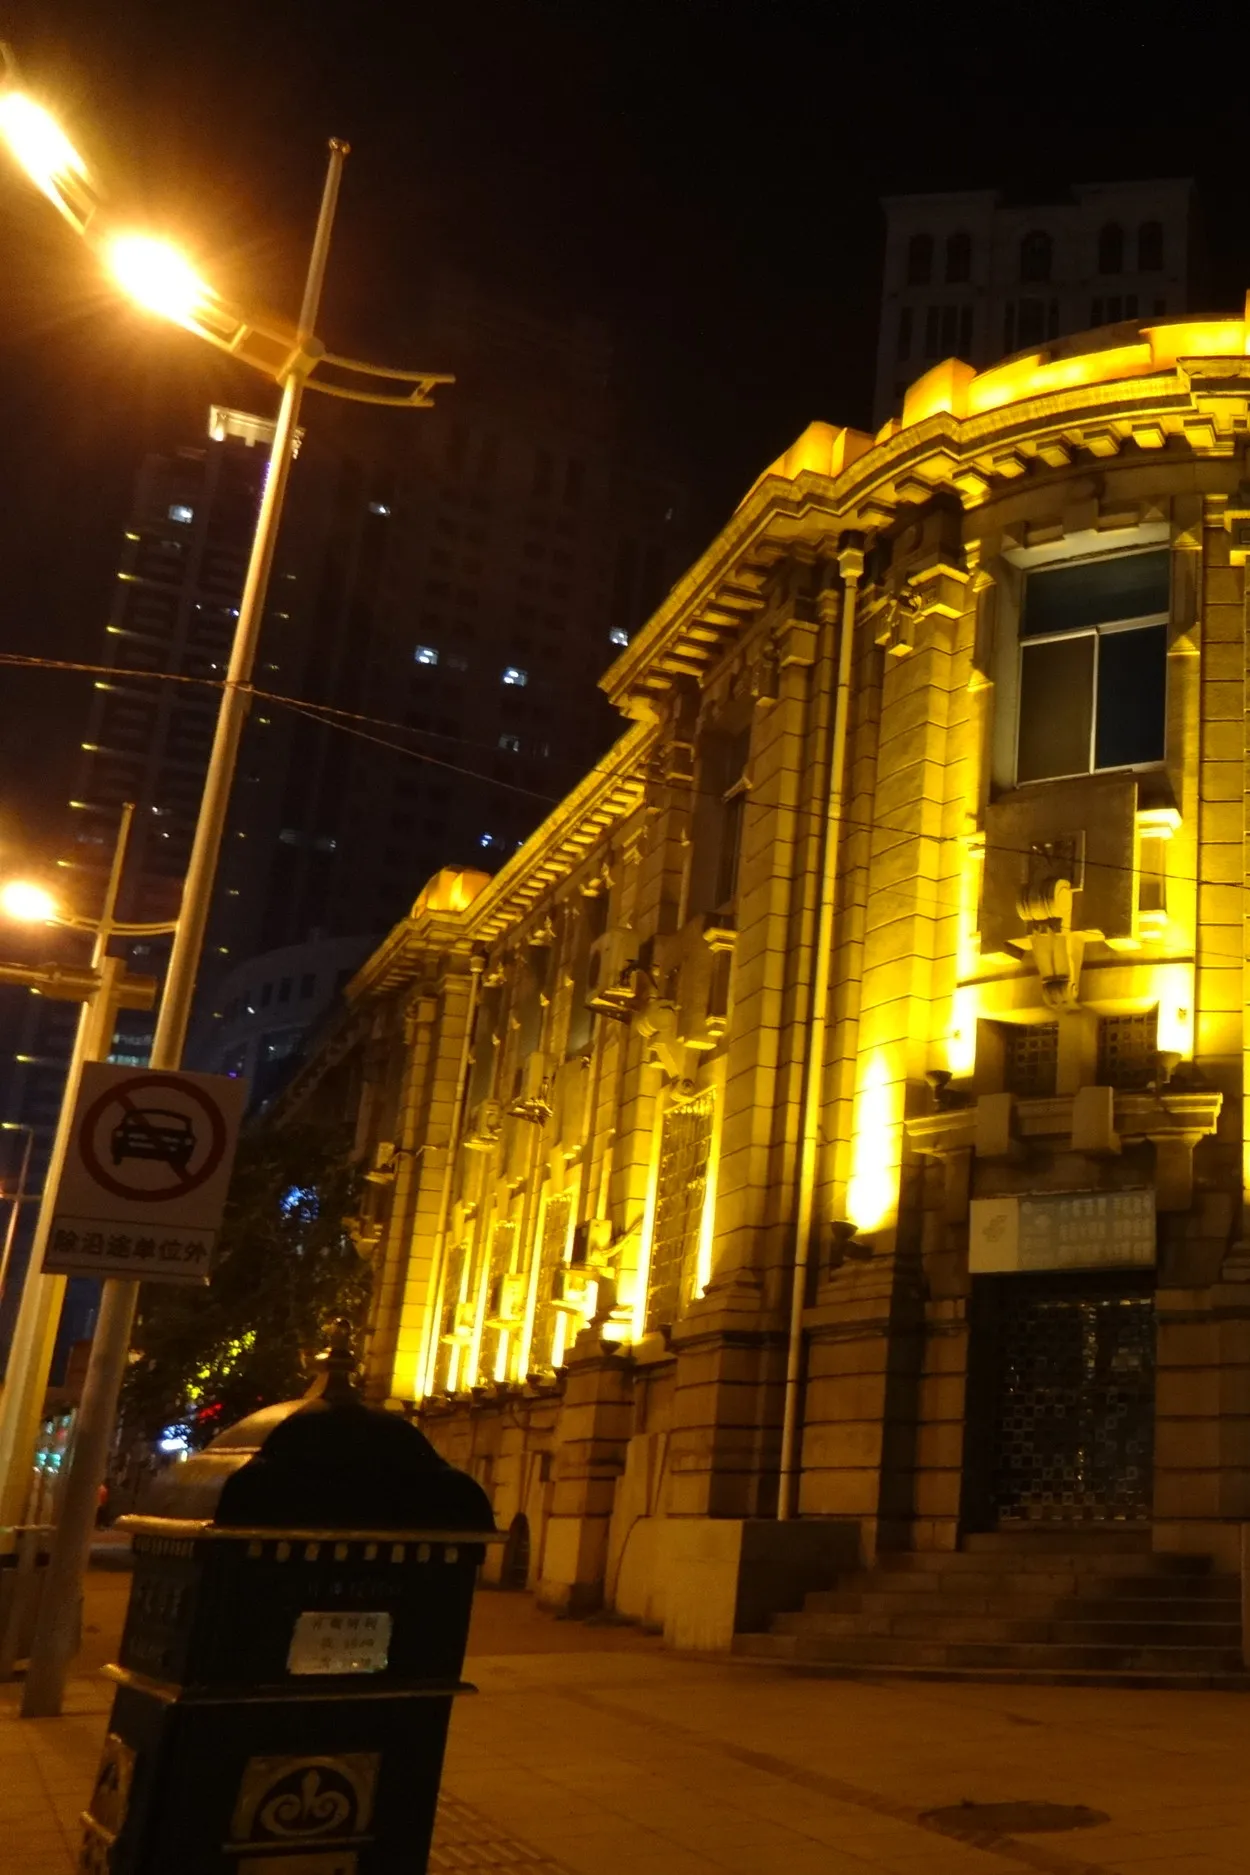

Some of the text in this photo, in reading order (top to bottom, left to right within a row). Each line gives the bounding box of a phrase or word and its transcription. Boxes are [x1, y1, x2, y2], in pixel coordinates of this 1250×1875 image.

[54, 1230, 207, 1263] 除沿途单位外
